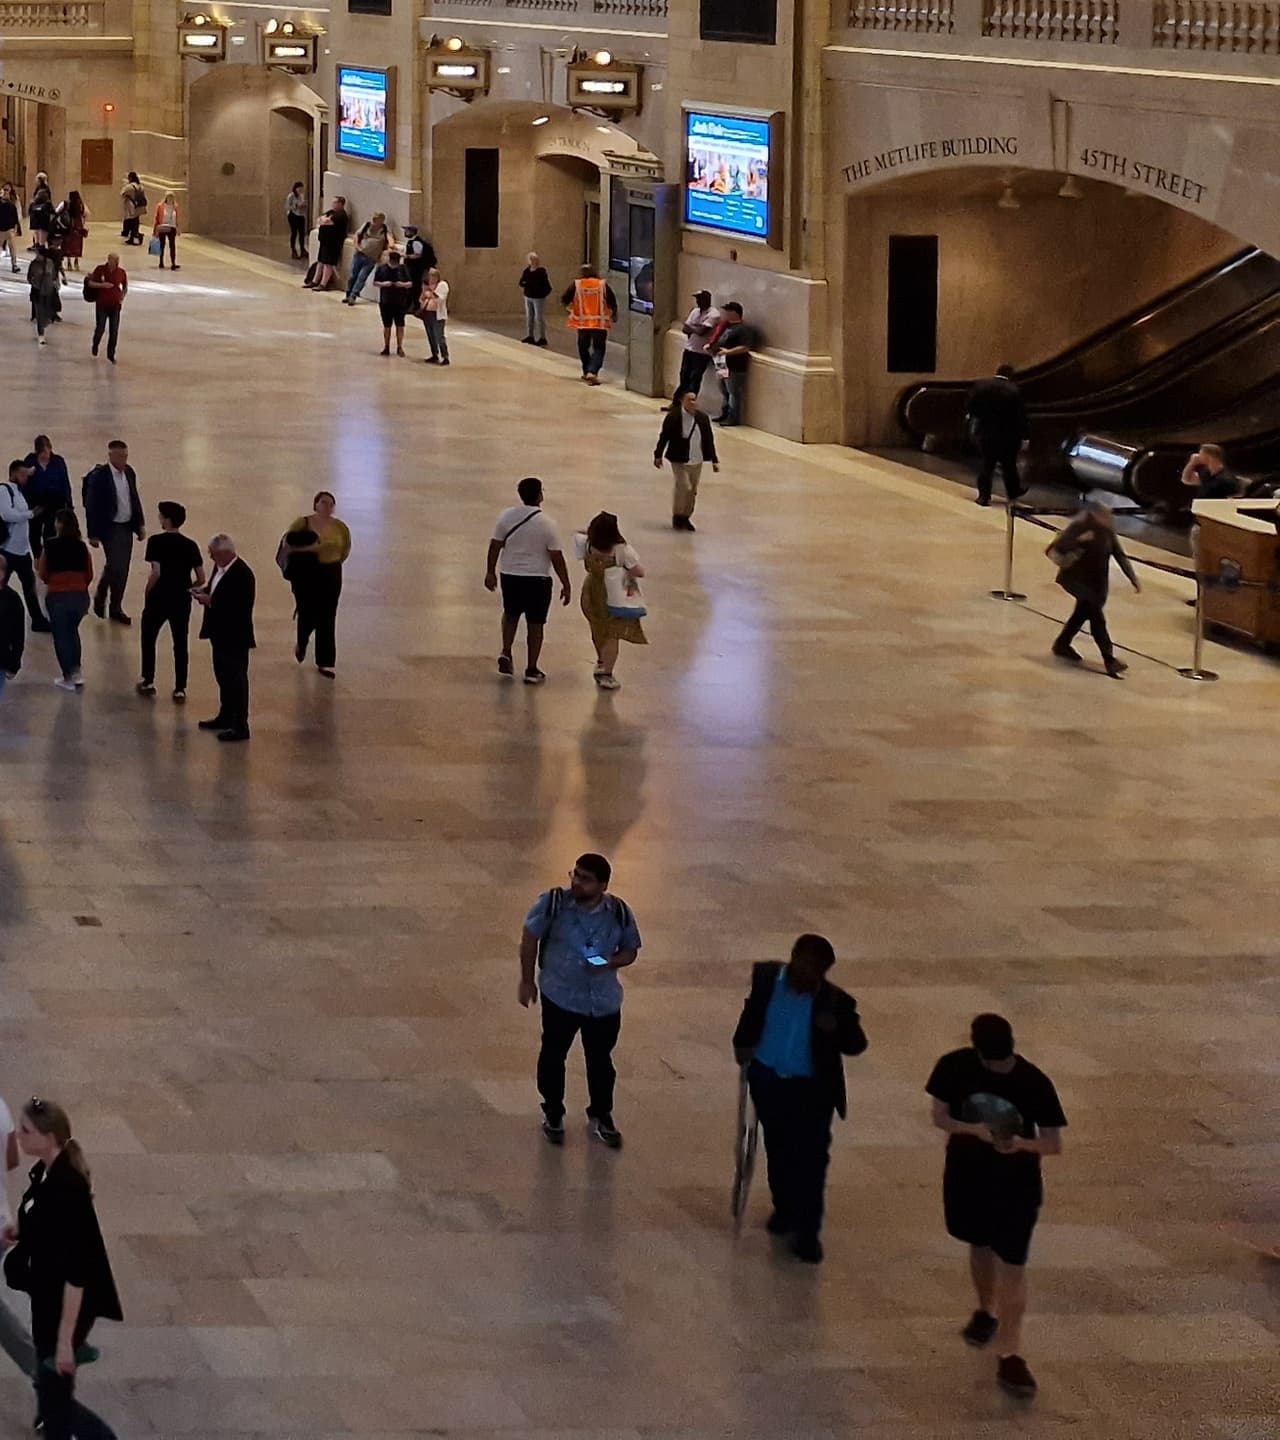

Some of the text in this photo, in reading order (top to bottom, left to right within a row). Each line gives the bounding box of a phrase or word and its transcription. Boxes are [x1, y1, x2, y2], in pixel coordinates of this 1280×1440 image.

[17, 82, 46, 98] LIRR
[842, 136, 1018, 184] THE METLIFE BUILDING
[1080, 148, 1207, 204] 45TH STREET
